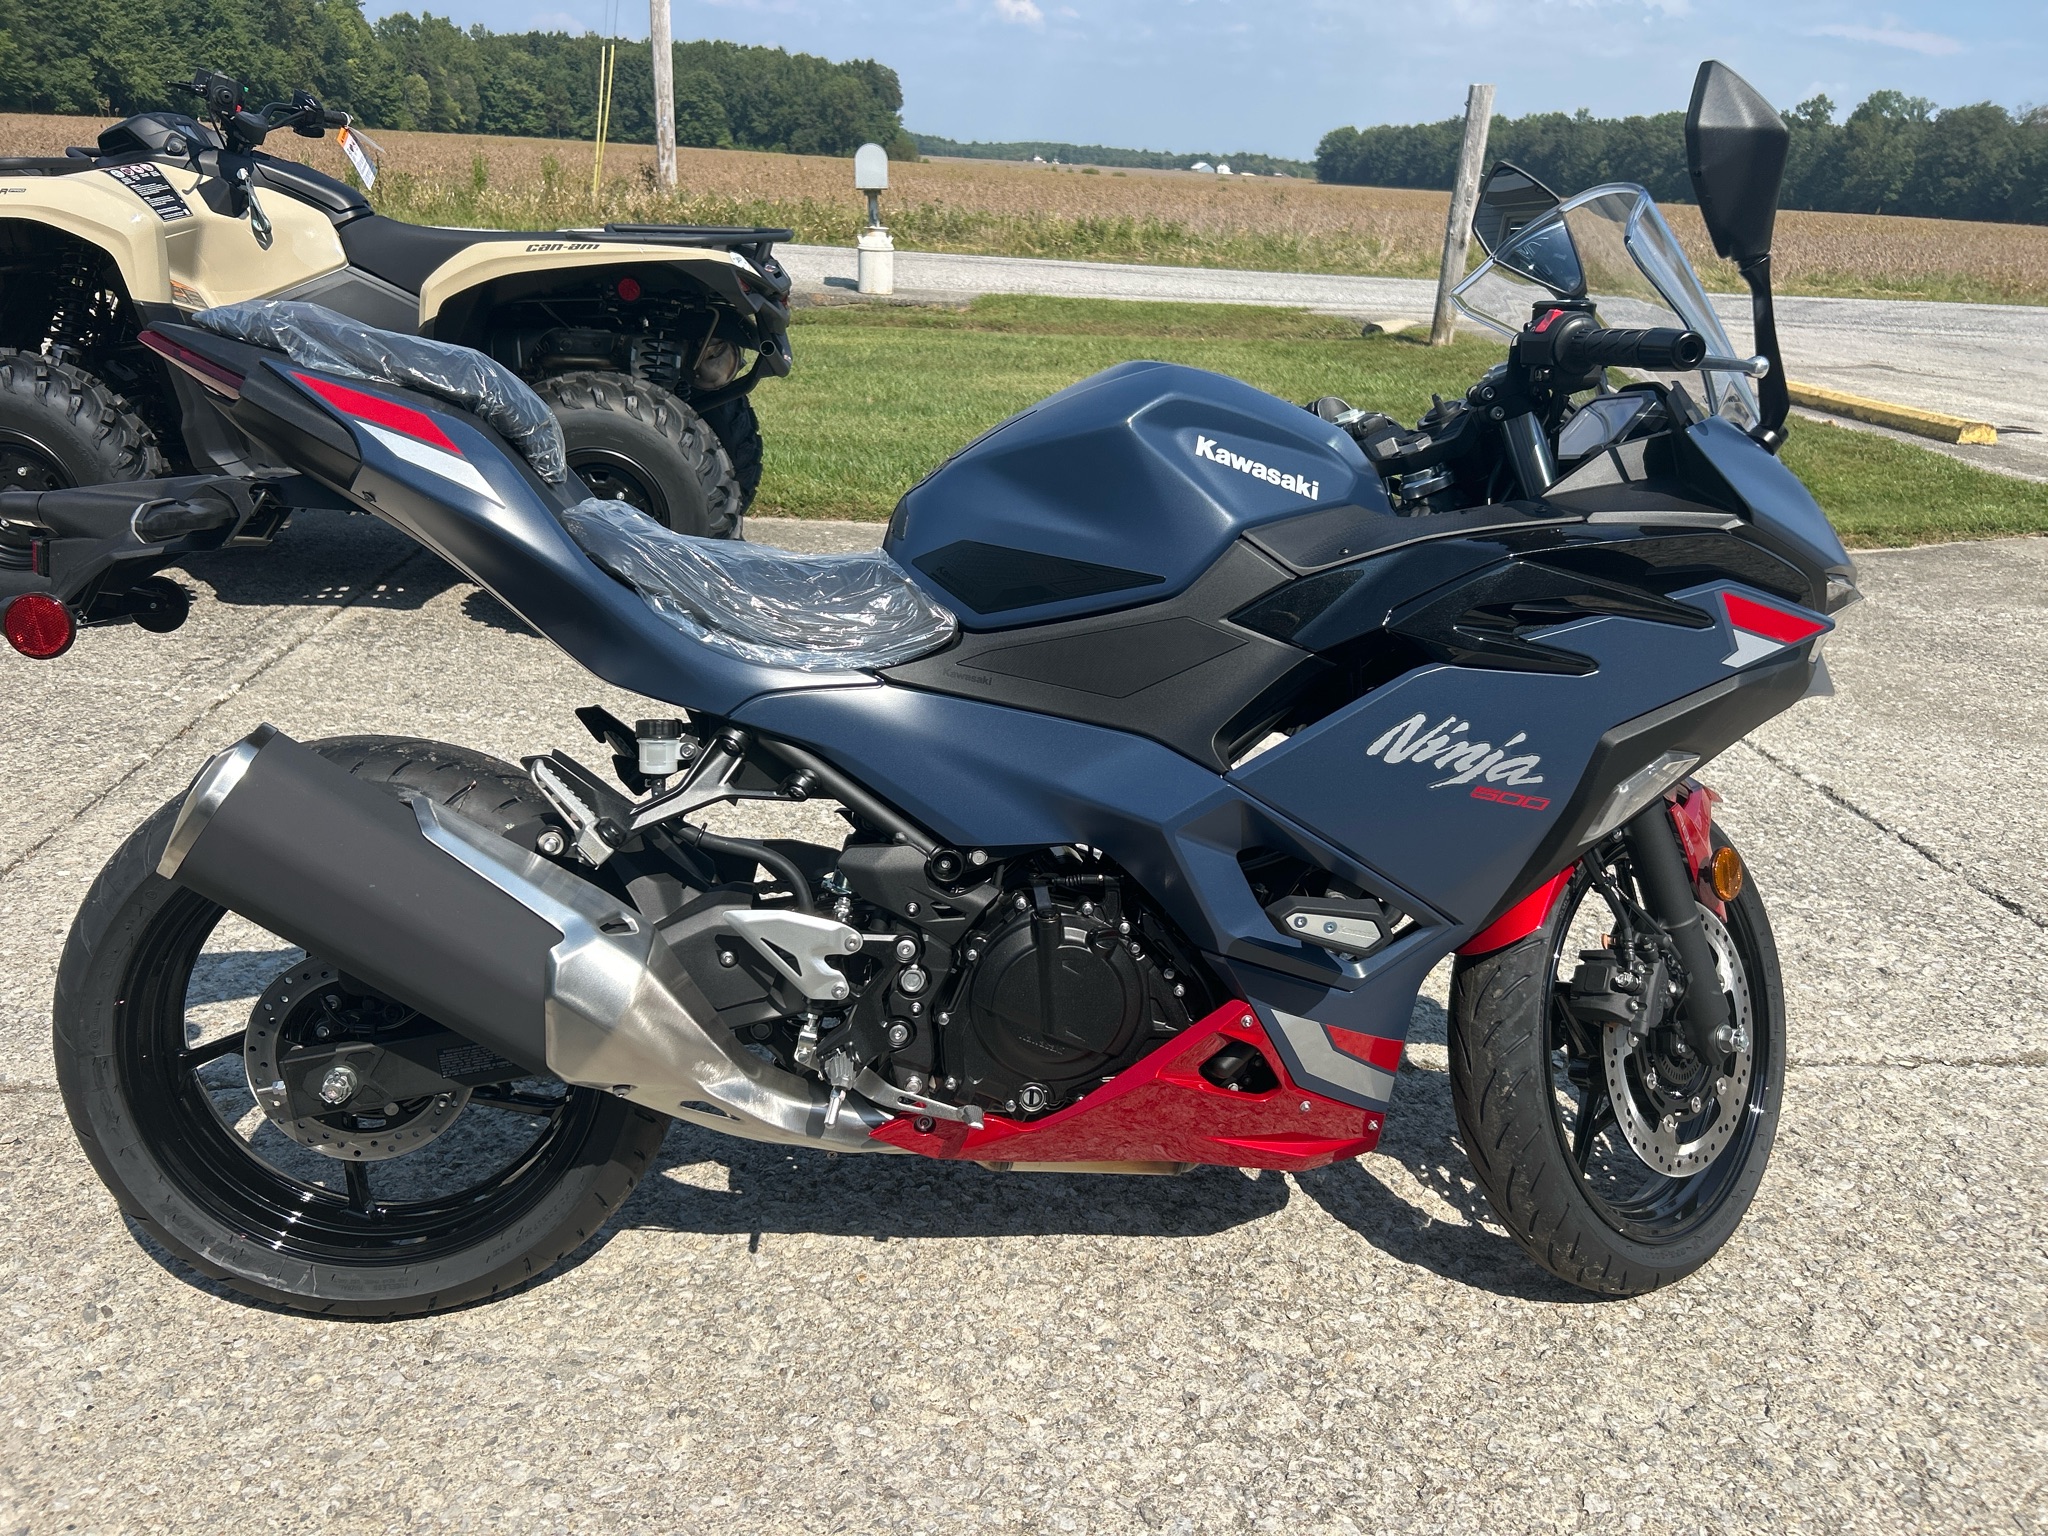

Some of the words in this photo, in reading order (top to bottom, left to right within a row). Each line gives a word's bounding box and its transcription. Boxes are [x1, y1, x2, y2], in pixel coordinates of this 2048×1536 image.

[525, 243, 600, 253] can-am
[1195, 434, 1319, 501] Kawasaki
[942, 666, 994, 686] Kawasaki
[1366, 713, 1544, 789] Ninja
[1470, 785, 1550, 811] 500
